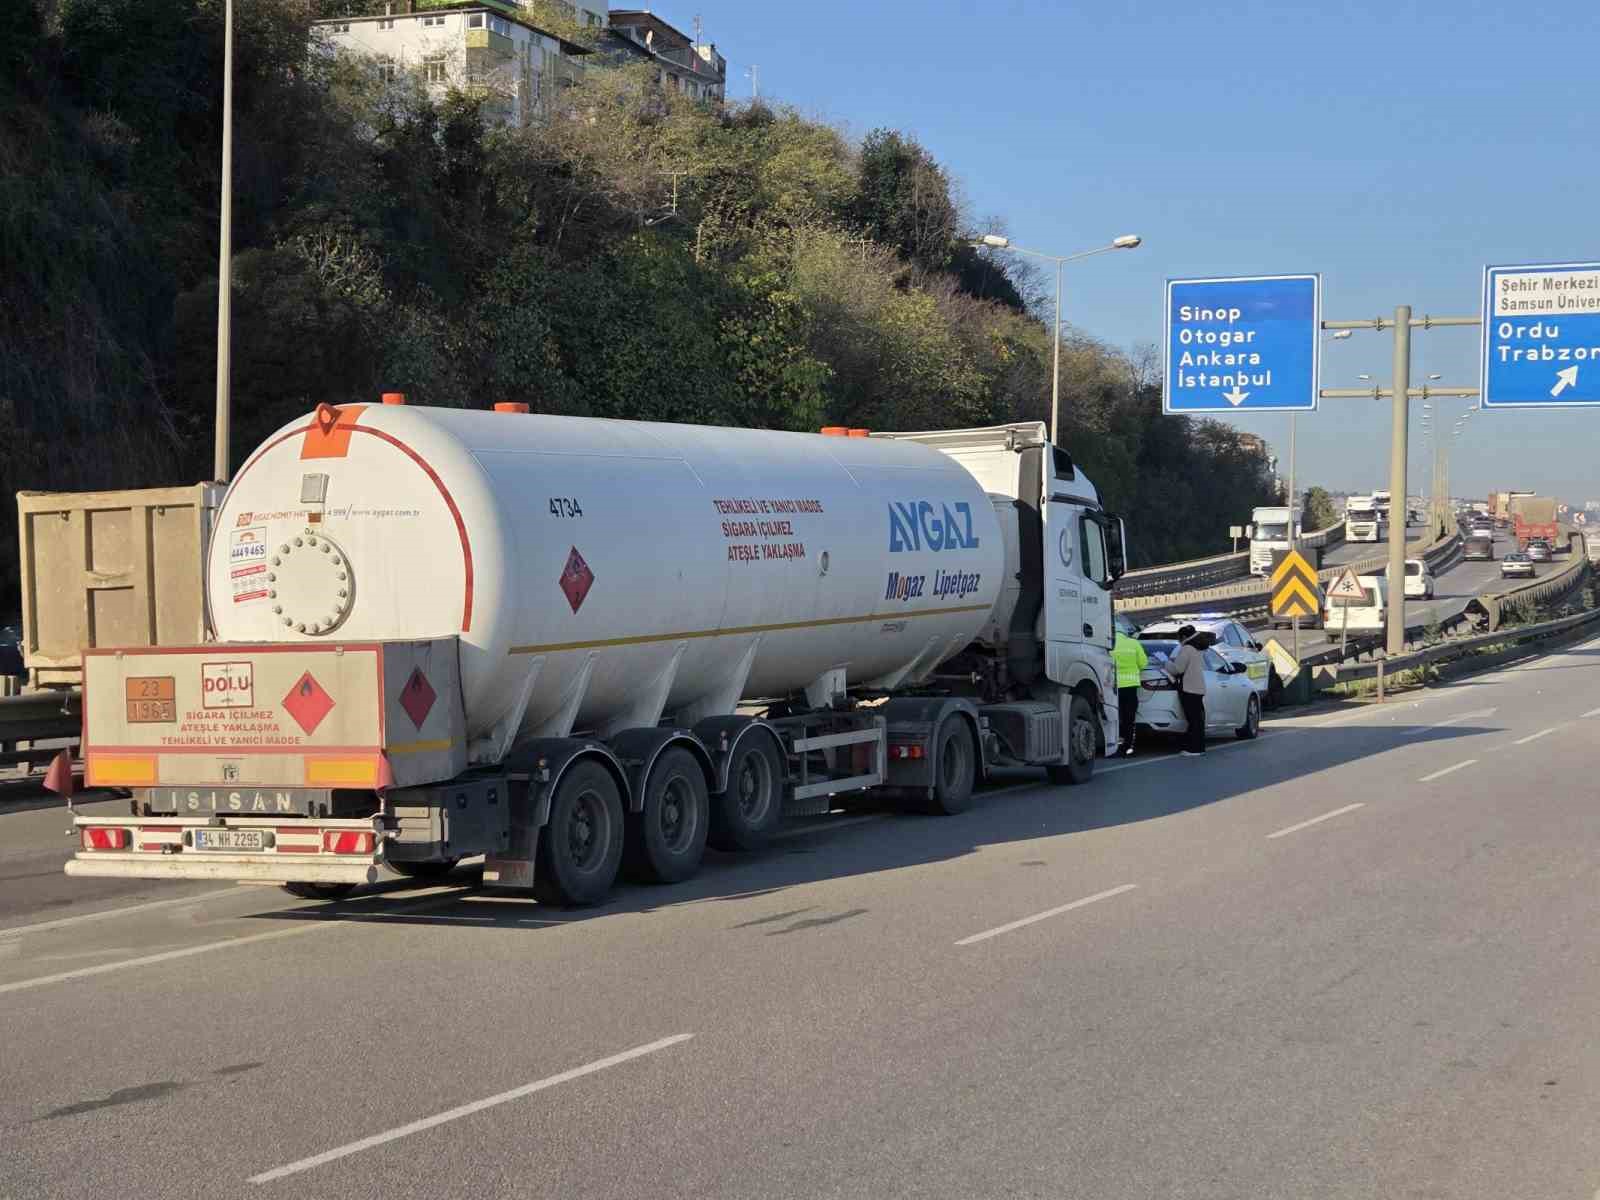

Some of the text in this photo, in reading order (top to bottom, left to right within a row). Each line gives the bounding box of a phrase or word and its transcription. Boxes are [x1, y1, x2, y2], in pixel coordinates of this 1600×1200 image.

[1501, 276, 1598, 295] Şehir Merkezi
[1501, 298, 1553, 311] Samsun
[1179, 306, 1241, 323] Sinop
[1179, 329, 1256, 347] Otogar
[1499, 322, 1559, 338] Ordu
[1179, 351, 1261, 367] Ankara
[1498, 344, 1600, 362] Trabzon
[1178, 369, 1272, 388] İstanbul
[550, 497, 583, 518] 4734
[757, 499, 770, 513] VE
[721, 519, 758, 537] SİGARA
[888, 501, 980, 553] AYGAZ
[728, 543, 806, 564] ATEŞLE YAKLAŞMA
[885, 569, 981, 601] Mogaz Lipetgaz
[141, 680, 160, 697] 23
[204, 676, 249, 692] DOLU
[180, 723, 280, 734] ATEŞLE YAKLAŞMA
[214, 736, 226, 745] VE
[265, 736, 301, 745] MADDE
[201, 831, 260, 848] 34 NH 2295
